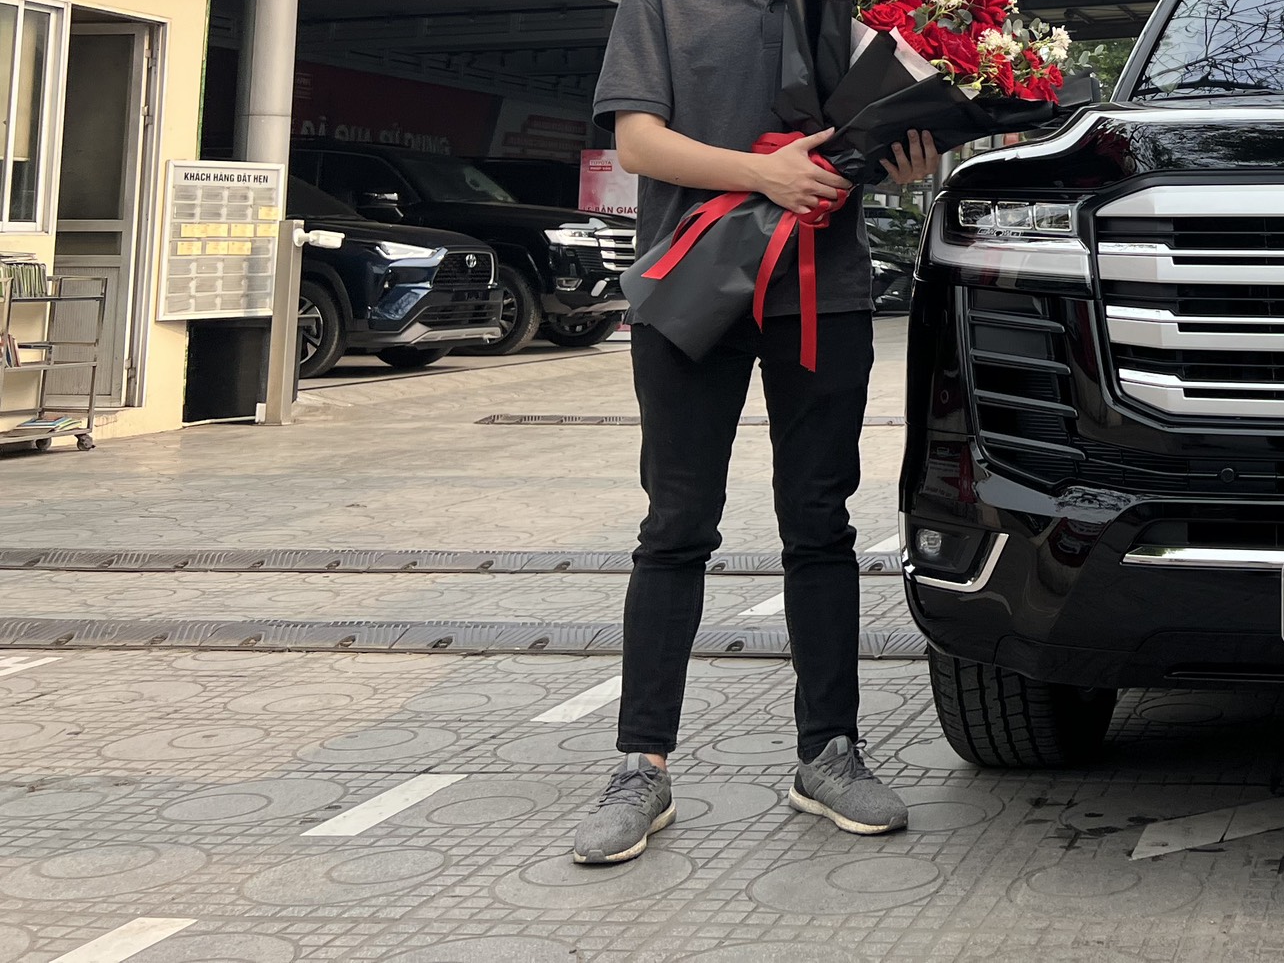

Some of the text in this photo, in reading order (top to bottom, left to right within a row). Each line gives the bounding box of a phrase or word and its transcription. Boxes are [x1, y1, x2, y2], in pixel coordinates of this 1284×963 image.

[184, 170, 269, 185] KHÁCH HÀNG ĐẶT HẸN
